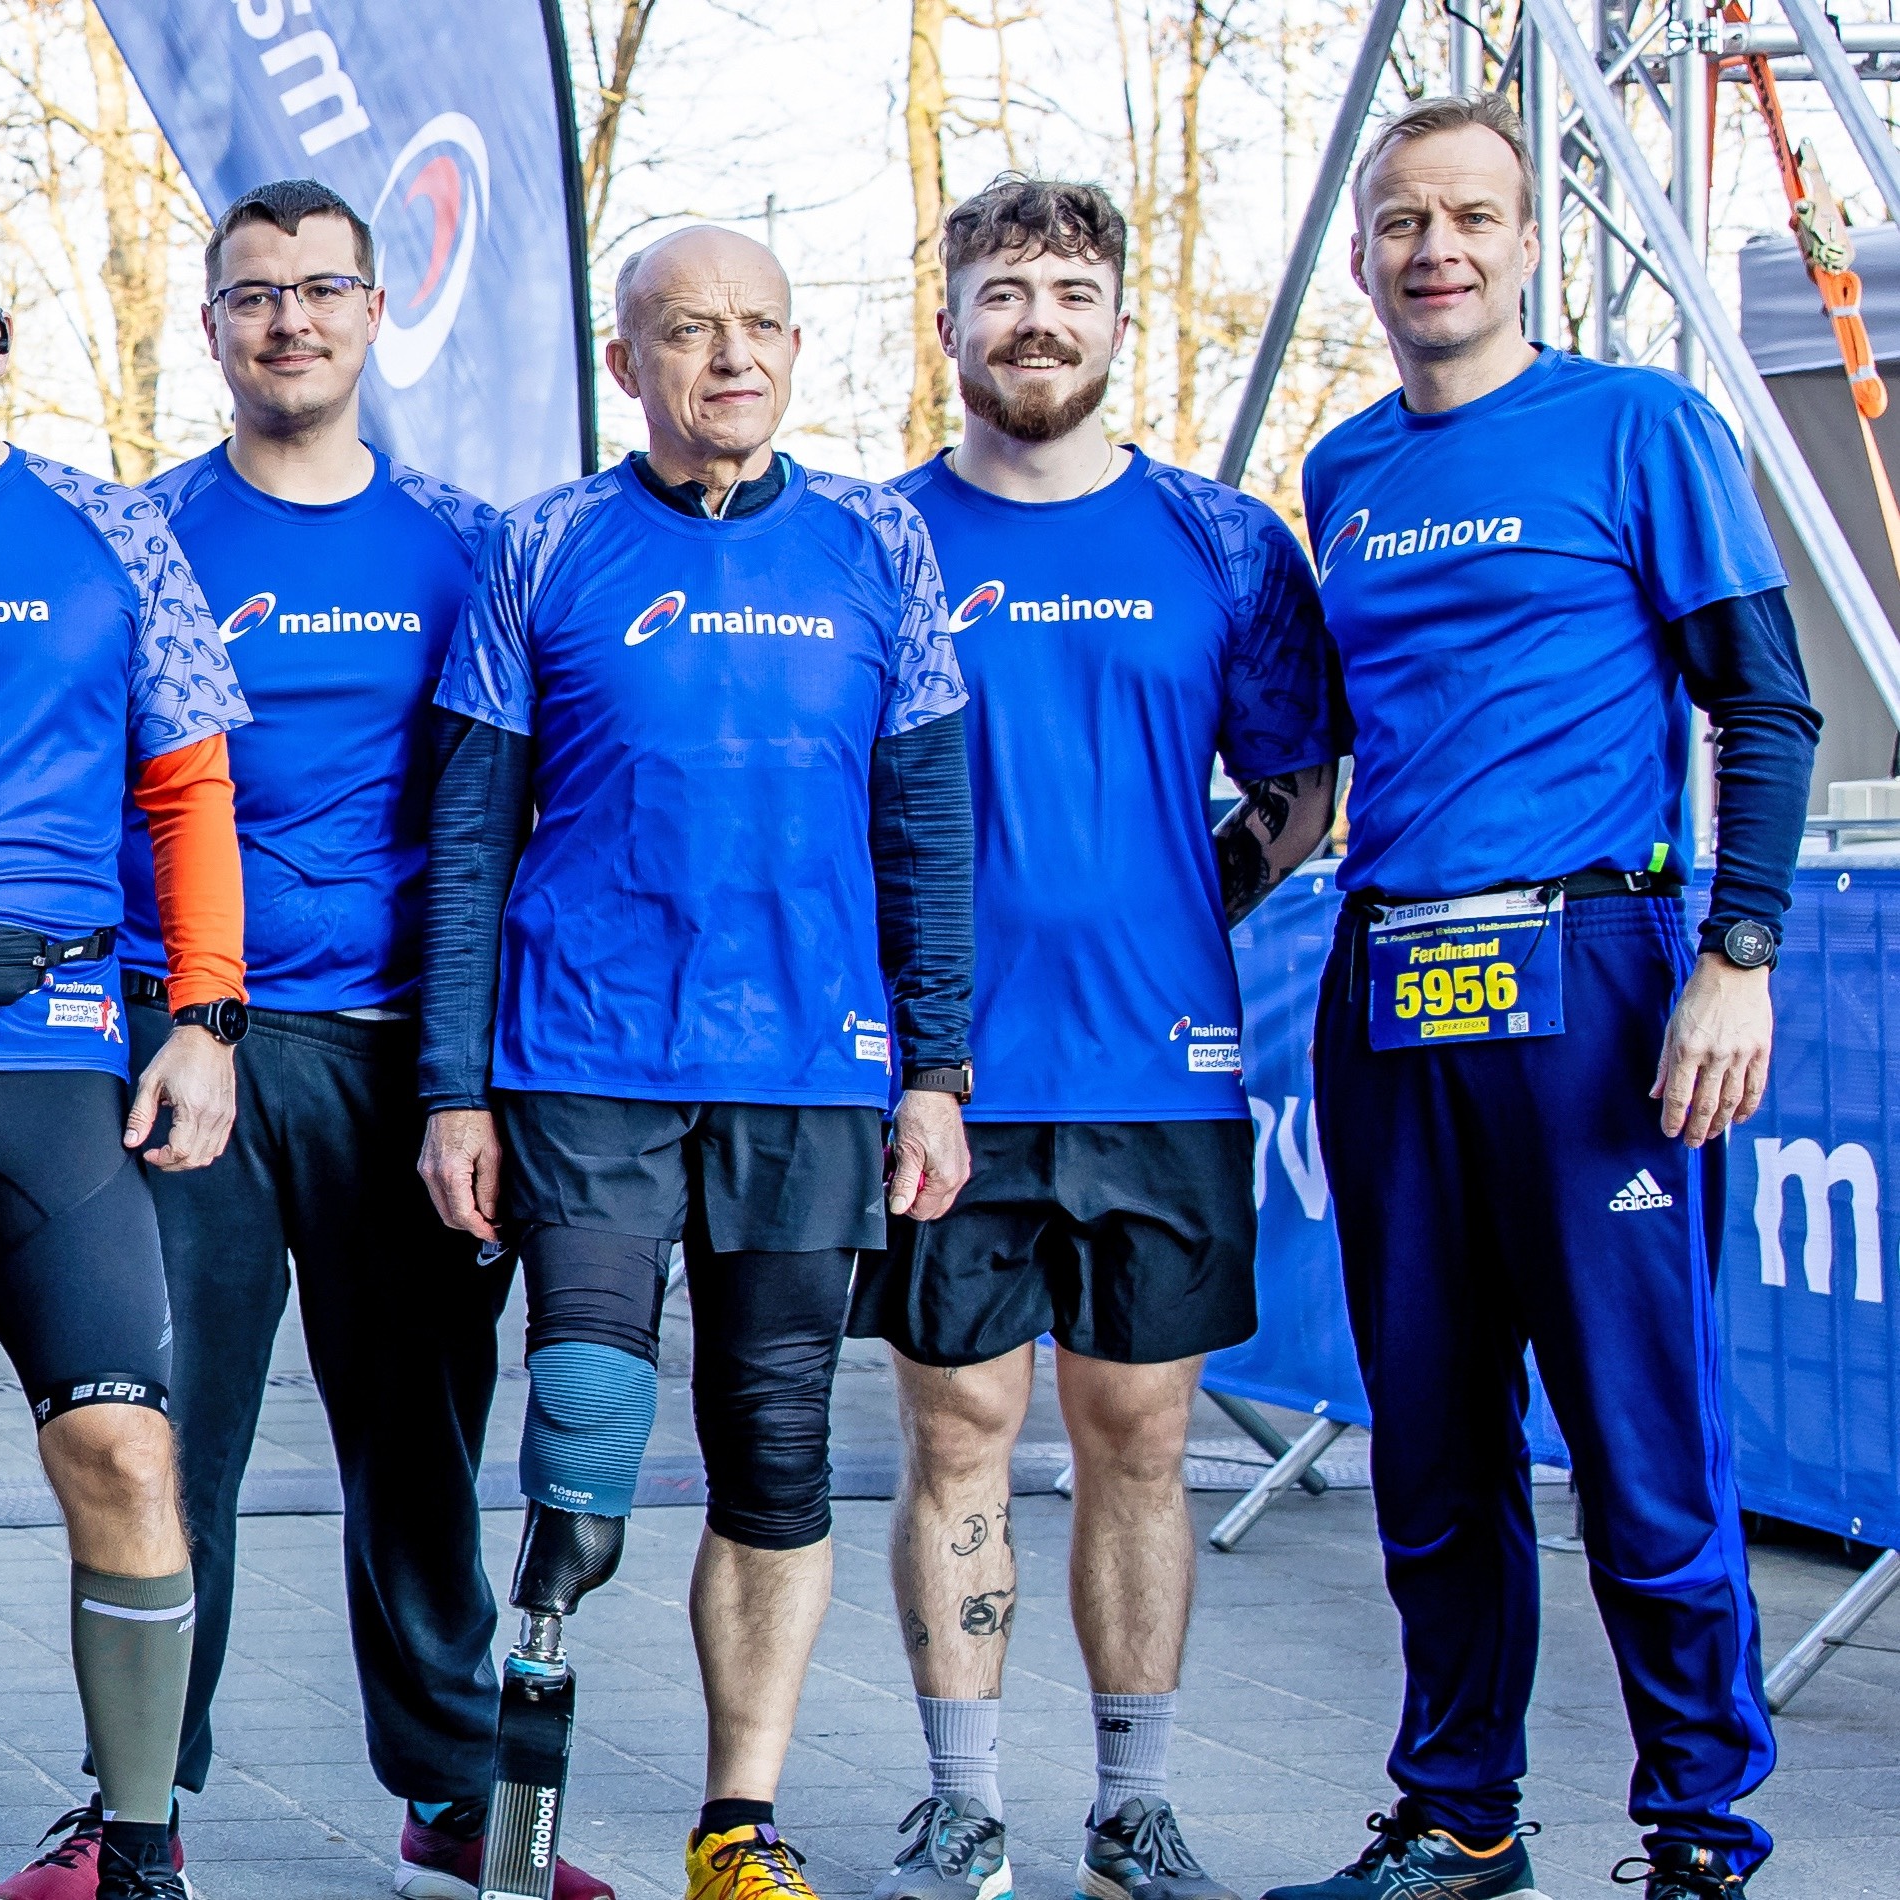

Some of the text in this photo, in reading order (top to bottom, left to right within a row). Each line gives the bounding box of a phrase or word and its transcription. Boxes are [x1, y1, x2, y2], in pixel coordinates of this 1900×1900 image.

[1364, 516, 1522, 561] mainova
[279, 606, 421, 634] mainova
[1009, 594, 1153, 622] mainova
[689, 605, 834, 639] mainova
[1396, 903, 1450, 921] mainova
[1409, 937, 1500, 964] Ferdinand
[54, 981, 103, 994] mainova
[1395, 962, 1518, 1019] 5956
[55, 1003, 98, 1015] energie
[55, 1013, 98, 1024] akademie
[1609, 1194, 1673, 1212] adidas
[96, 1381, 147, 1402] cep
[531, 1786, 556, 1868] ottobock
